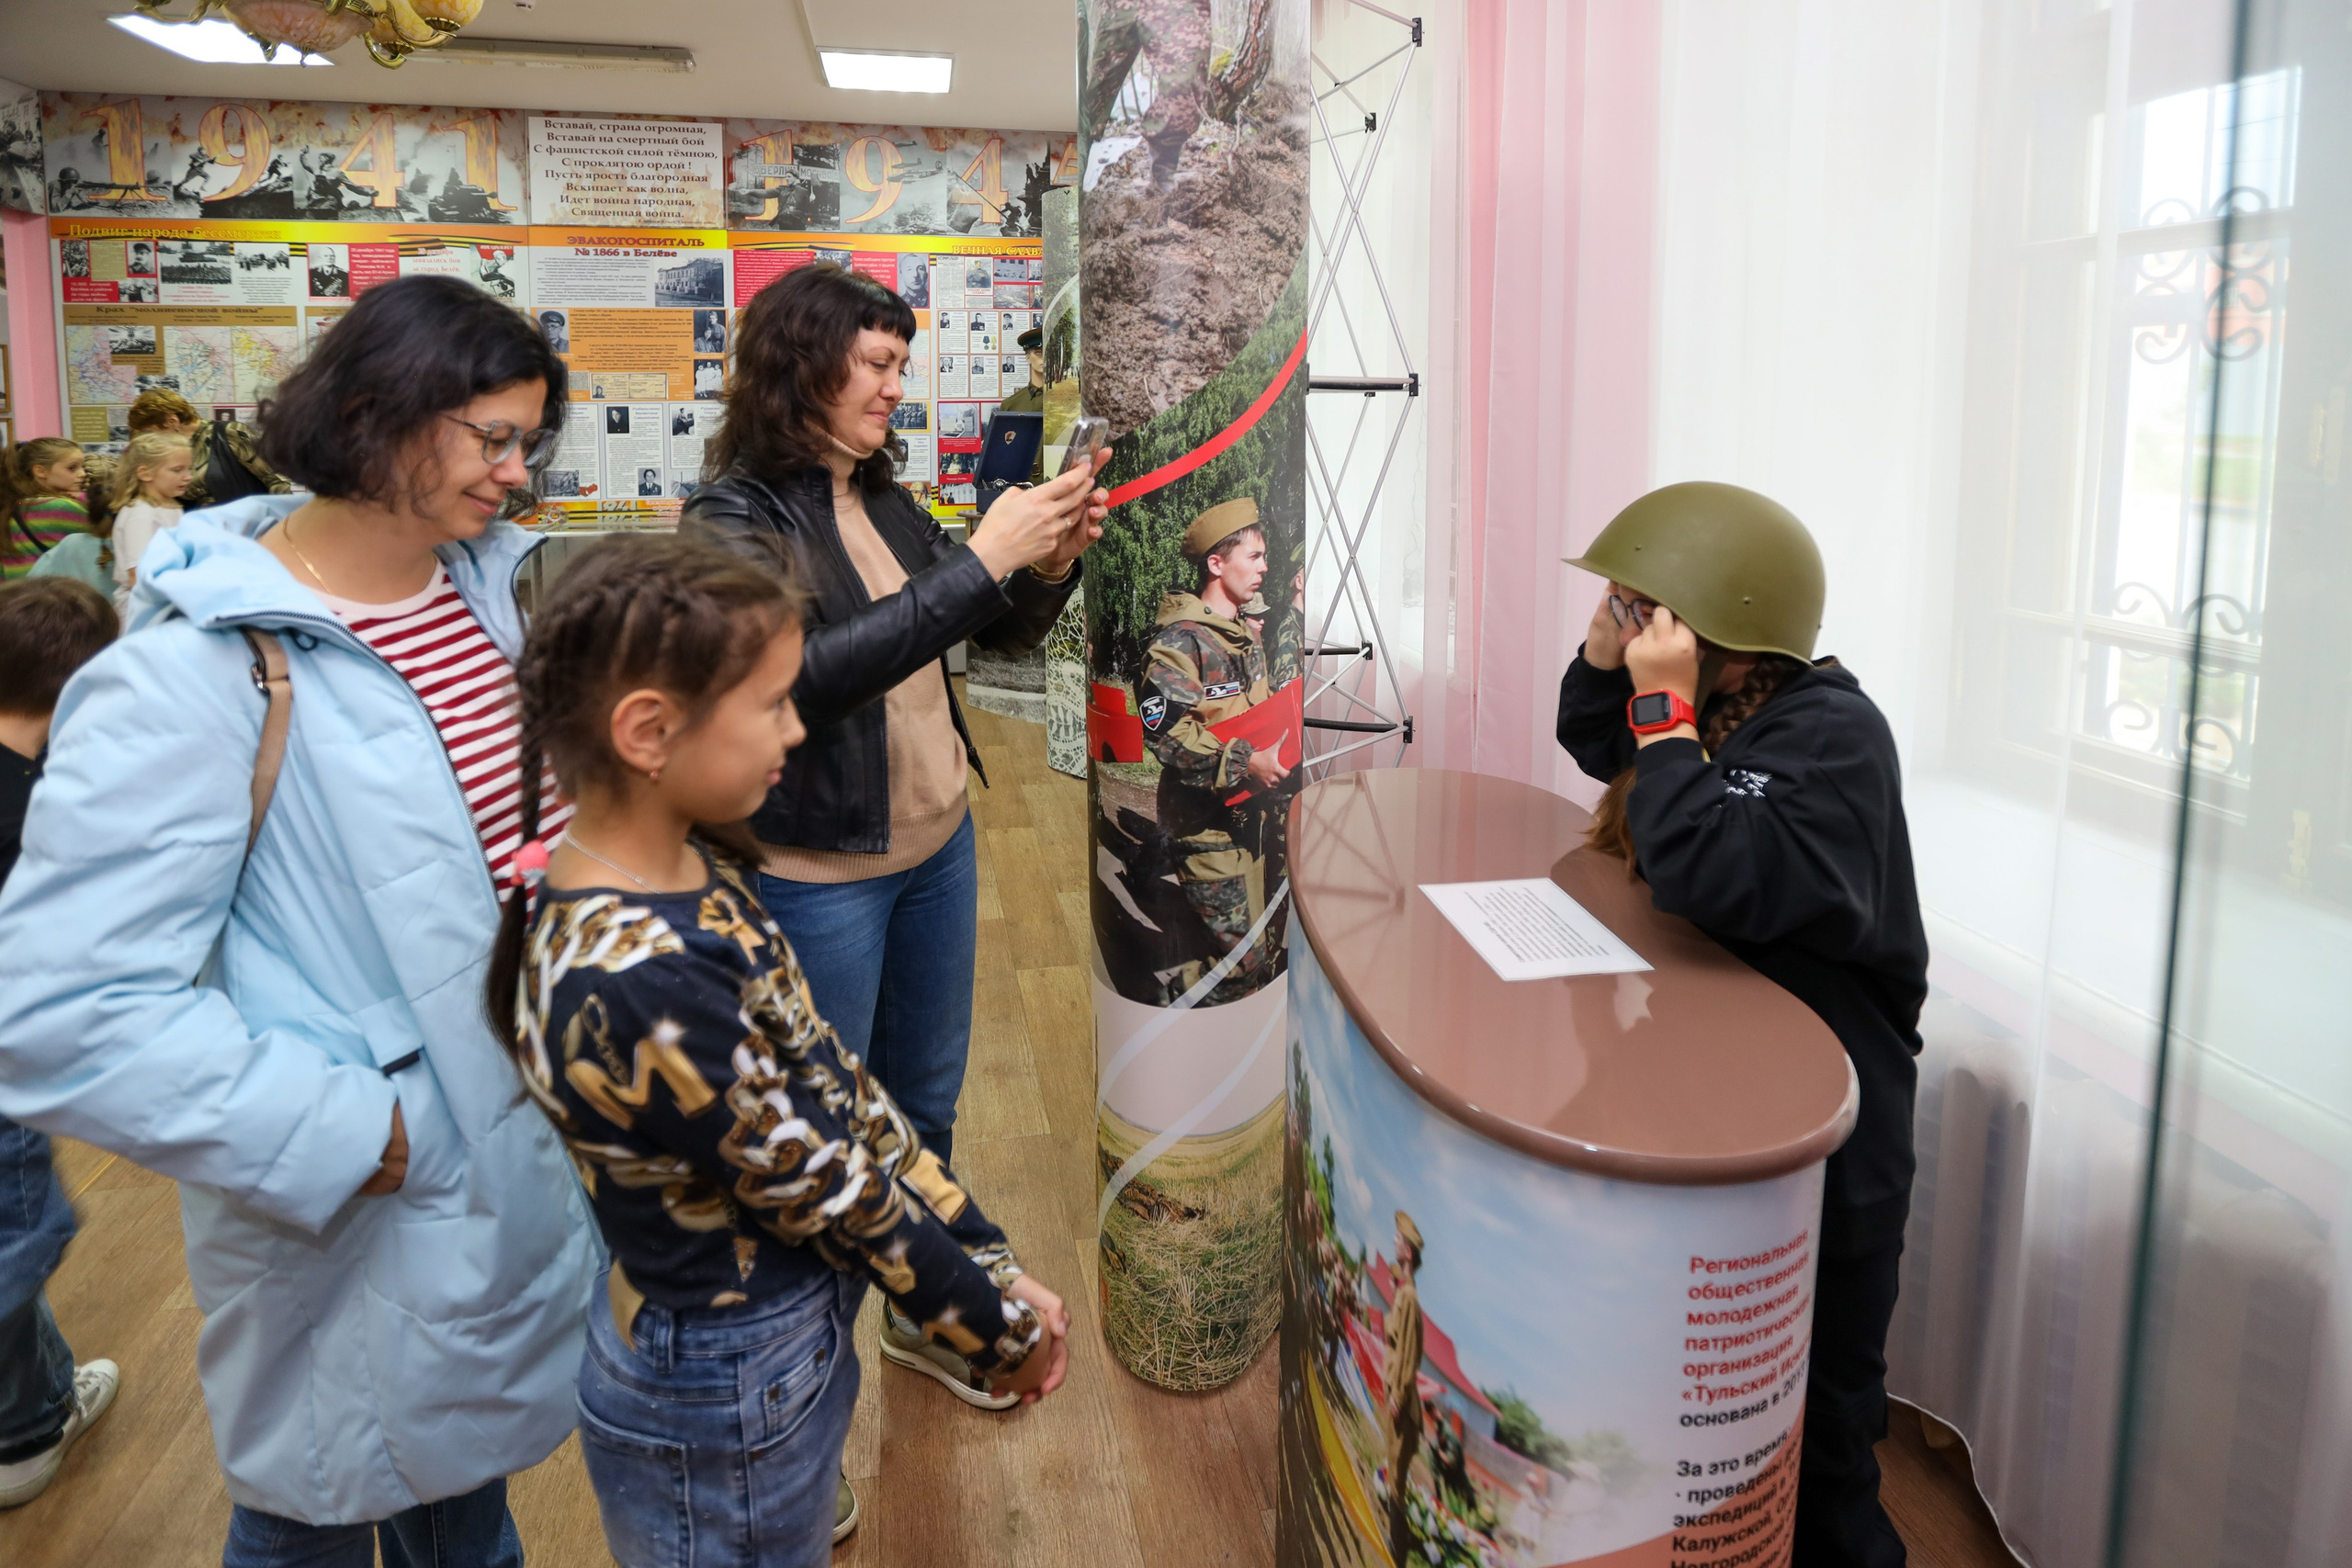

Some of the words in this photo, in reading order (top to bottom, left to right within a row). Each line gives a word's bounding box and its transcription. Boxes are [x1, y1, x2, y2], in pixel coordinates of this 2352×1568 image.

[544, 119, 595, 131] Вставай,
[600, 123, 641, 134] страна
[644, 125, 707, 135] огромная,
[547, 132, 595, 142] Вставай
[616, 136, 678, 146] смертный
[682, 135, 705, 146] бой
[80, 97, 518, 211] 1941
[534, 144, 542, 153] С
[546, 145, 624, 158] фашистской
[628, 147, 663, 157] силой
[667, 149, 718, 160] тёмною,
[561, 158, 571, 166] С
[573, 160, 644, 169] проклятою
[647, 160, 685, 171] ордой
[545, 169, 582, 180] Пусть
[585, 172, 628, 181] ярость
[630, 172, 707, 183] благородная
[566, 182, 624, 193] Вскипает
[627, 185, 647, 193] как
[650, 186, 688, 195] волна,
[560, 195, 590, 205] Идет
[594, 196, 630, 205] война
[633, 197, 695, 208] народная,
[571, 207, 641, 218] Священная
[645, 208, 684, 218] война.
[69, 224, 128, 237] Подвиг
[132, 229, 190, 241] народа
[567, 235, 705, 247] ЭВАКОГОСПИТАЛЬ
[574, 247, 590, 256] №
[592, 248, 620, 256] 1866
[633, 248, 677, 257] Белёве
[952, 245, 1002, 255] ВЕЧНАЯ
[96, 306, 125, 315] Крах
[597, 501, 637, 512] 1941
[1690, 1229, 1809, 1274] Региональная
[1688, 1251, 1809, 1301] общественная
[1687, 1284, 1799, 1326] молодежная
[1683, 1336, 1793, 1381] организация
[1682, 1368, 1778, 1405] «Тульский
[1679, 1399, 1769, 1427] основана
[1773, 1392, 1781, 1406] в
[1677, 1459, 1702, 1477] За
[1708, 1458, 1740, 1475] это
[1688, 1461, 1782, 1506] проведены
[1673, 1482, 1778, 1529] экспедиций
